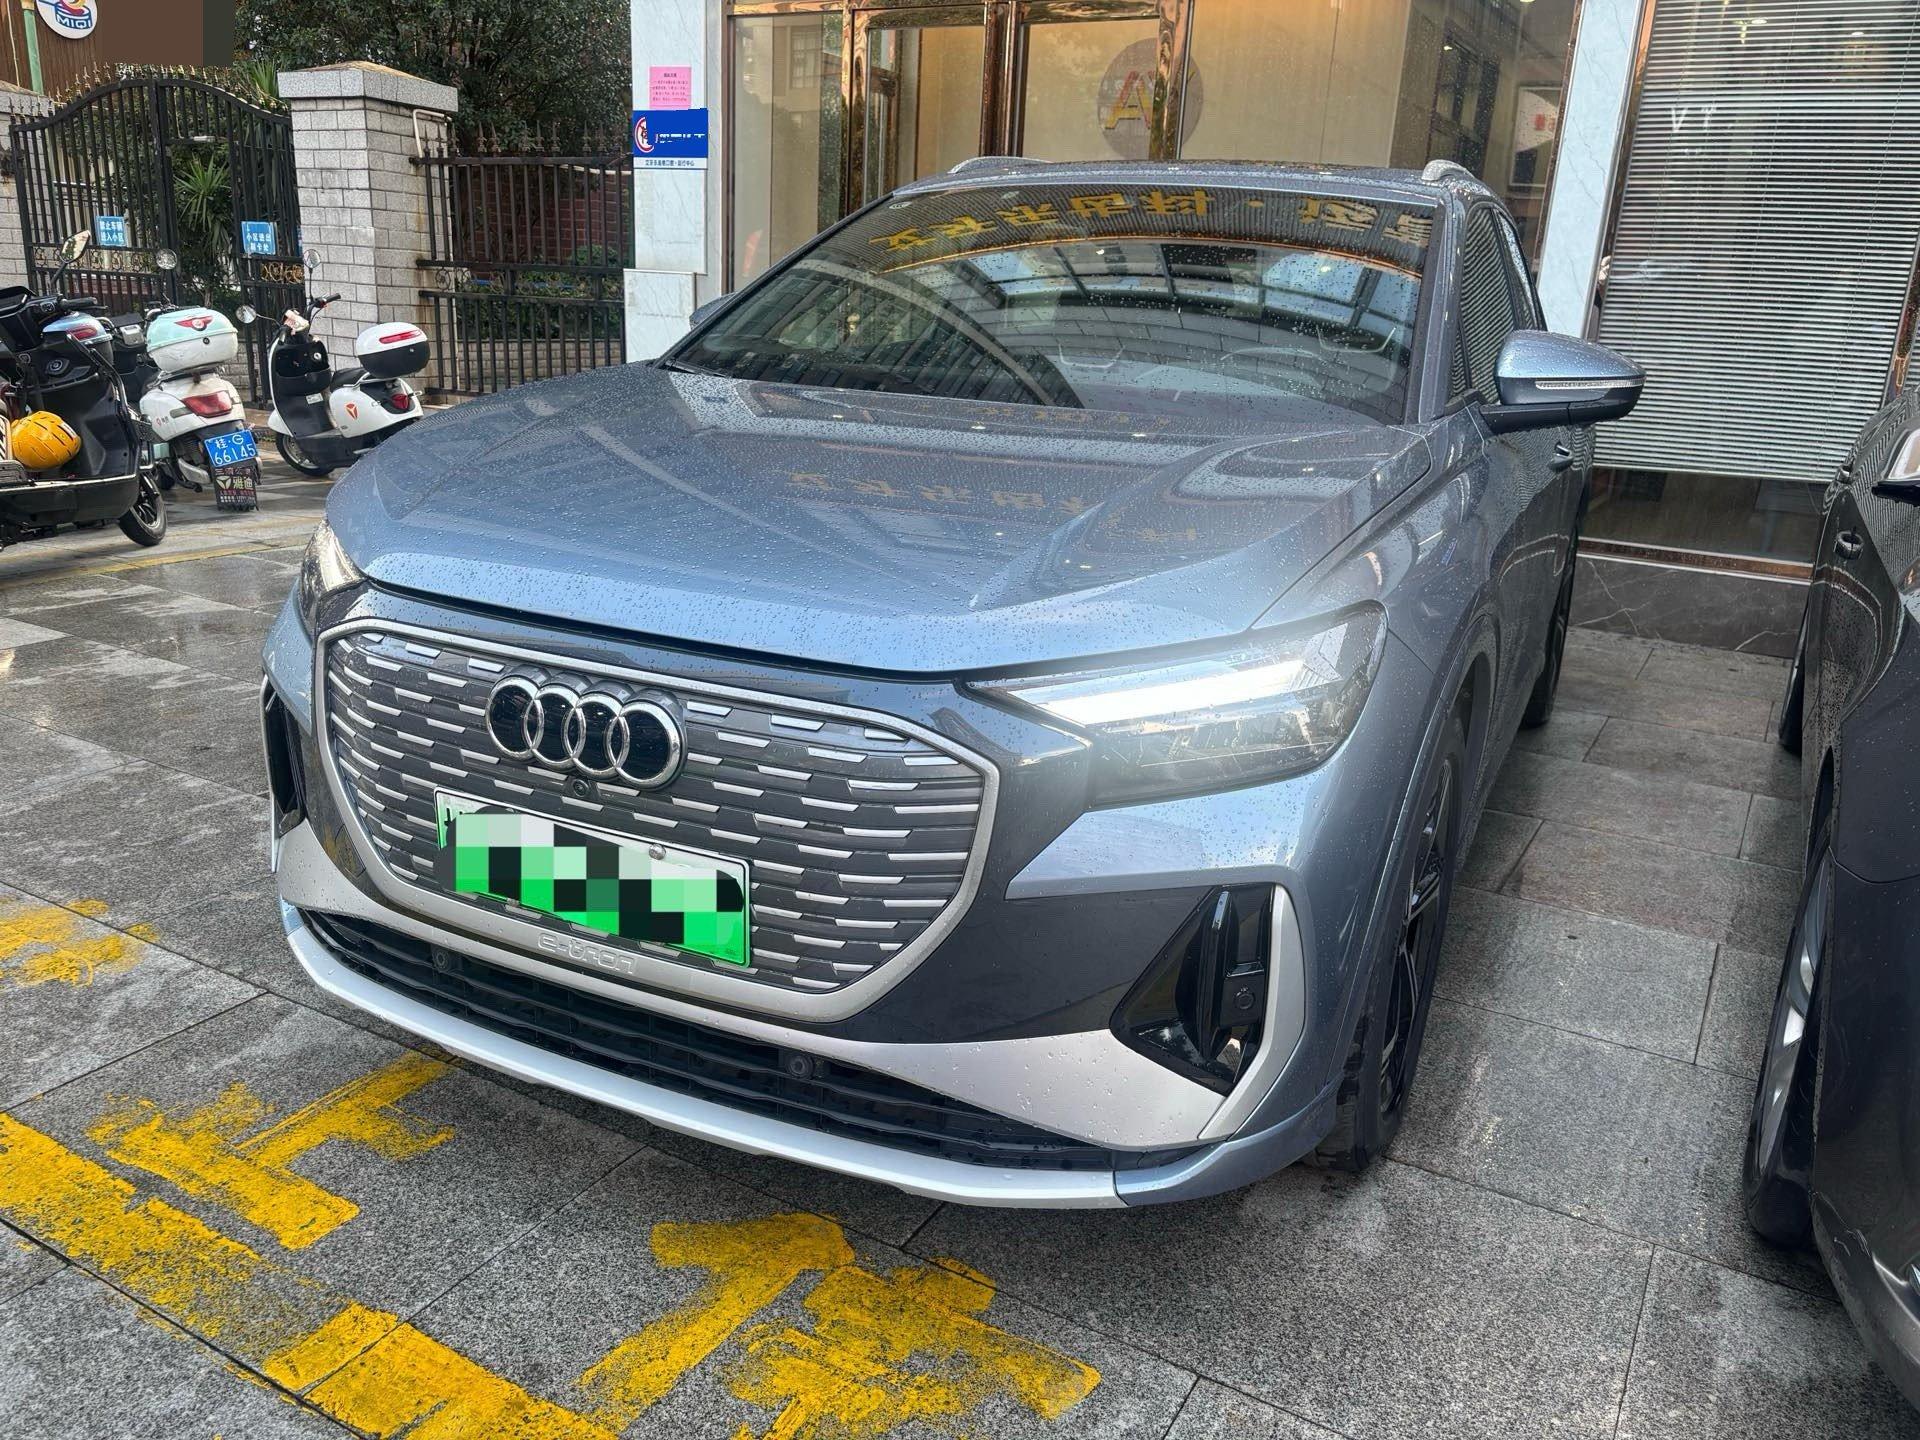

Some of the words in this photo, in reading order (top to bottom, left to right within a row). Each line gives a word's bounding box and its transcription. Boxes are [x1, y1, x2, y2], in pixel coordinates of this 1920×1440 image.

[56, 14, 92, 28] MIQI
[214, 443, 256, 465] 66145
[233, 476, 254, 490] 雅迪
[538, 932, 637, 975] e-tron
